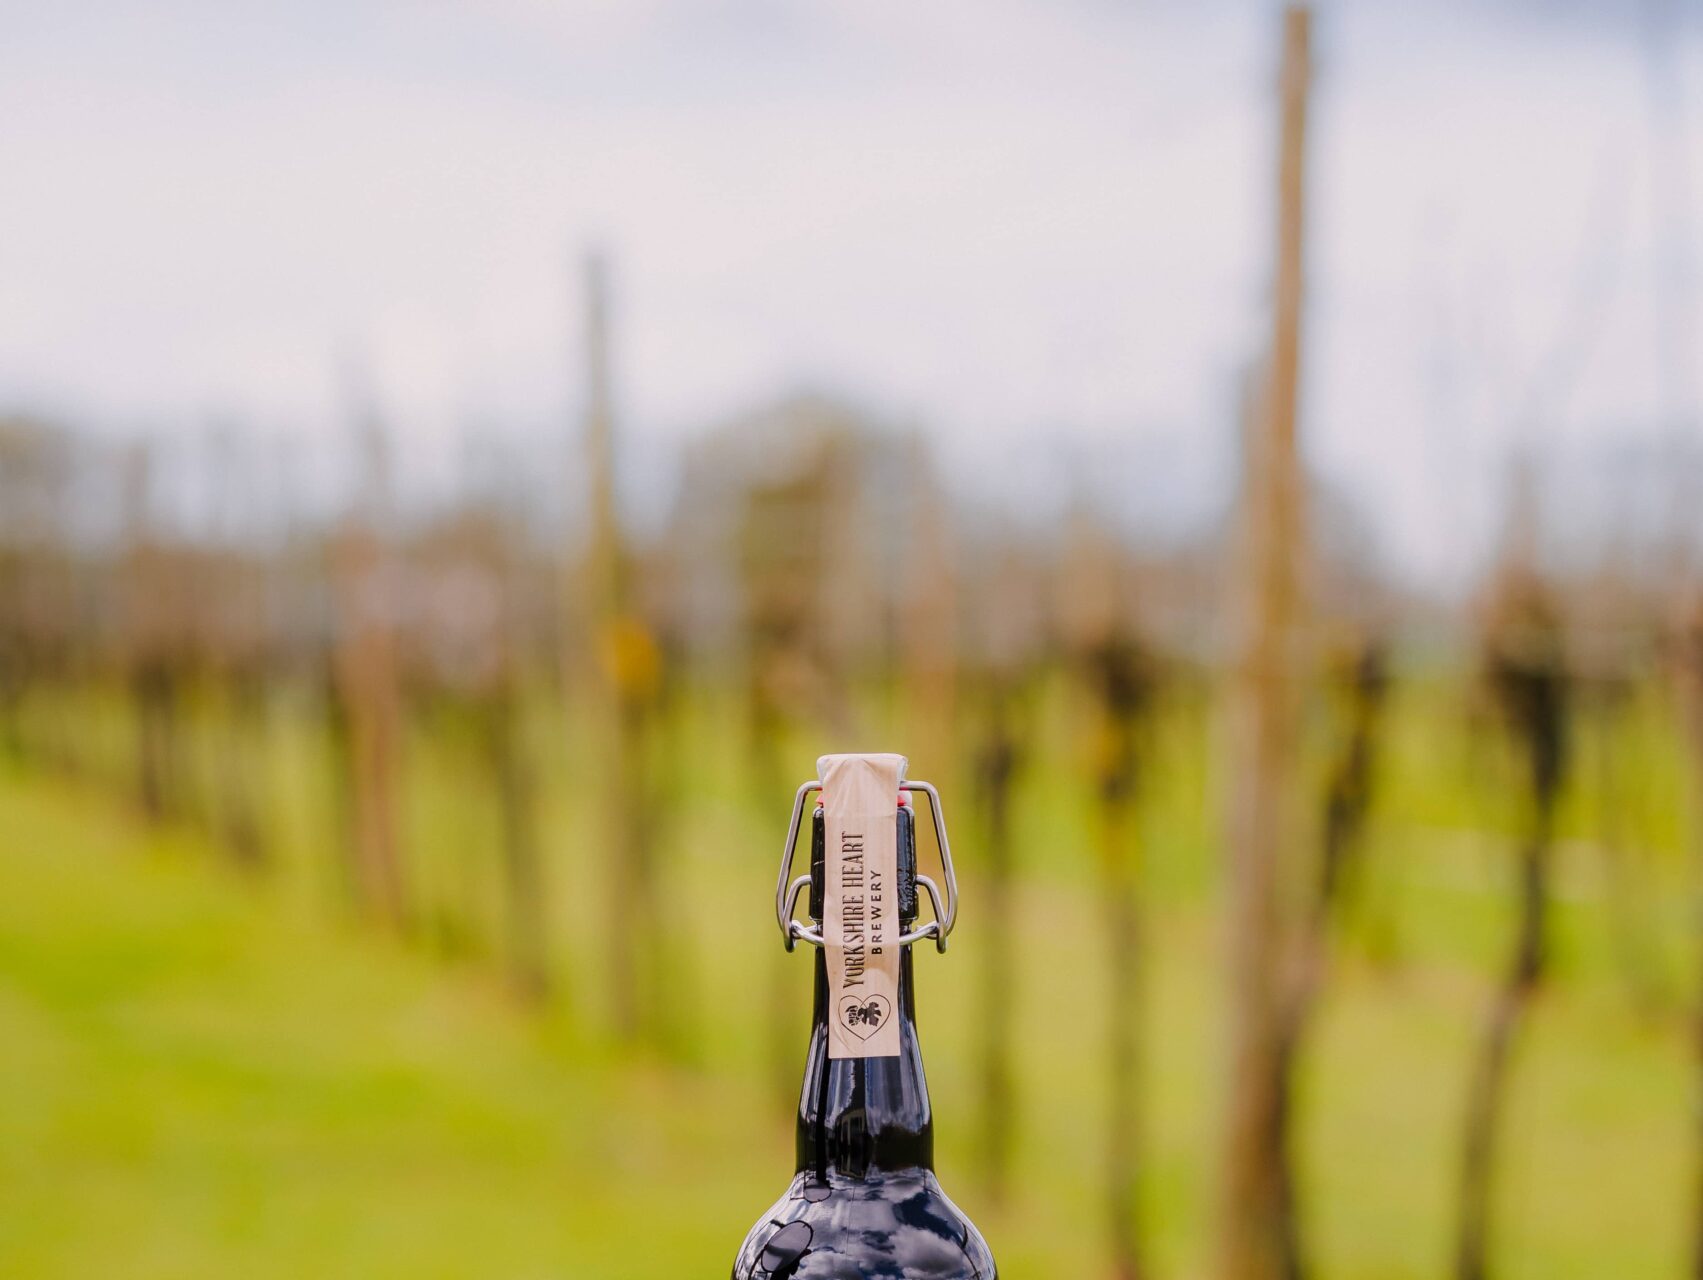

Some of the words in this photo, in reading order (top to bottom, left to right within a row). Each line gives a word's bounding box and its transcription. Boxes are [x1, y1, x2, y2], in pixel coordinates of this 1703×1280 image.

[841, 830, 864, 889] HEART
[842, 893, 865, 989] YORKSHIRE
[870, 869, 883, 955] BREWERY
